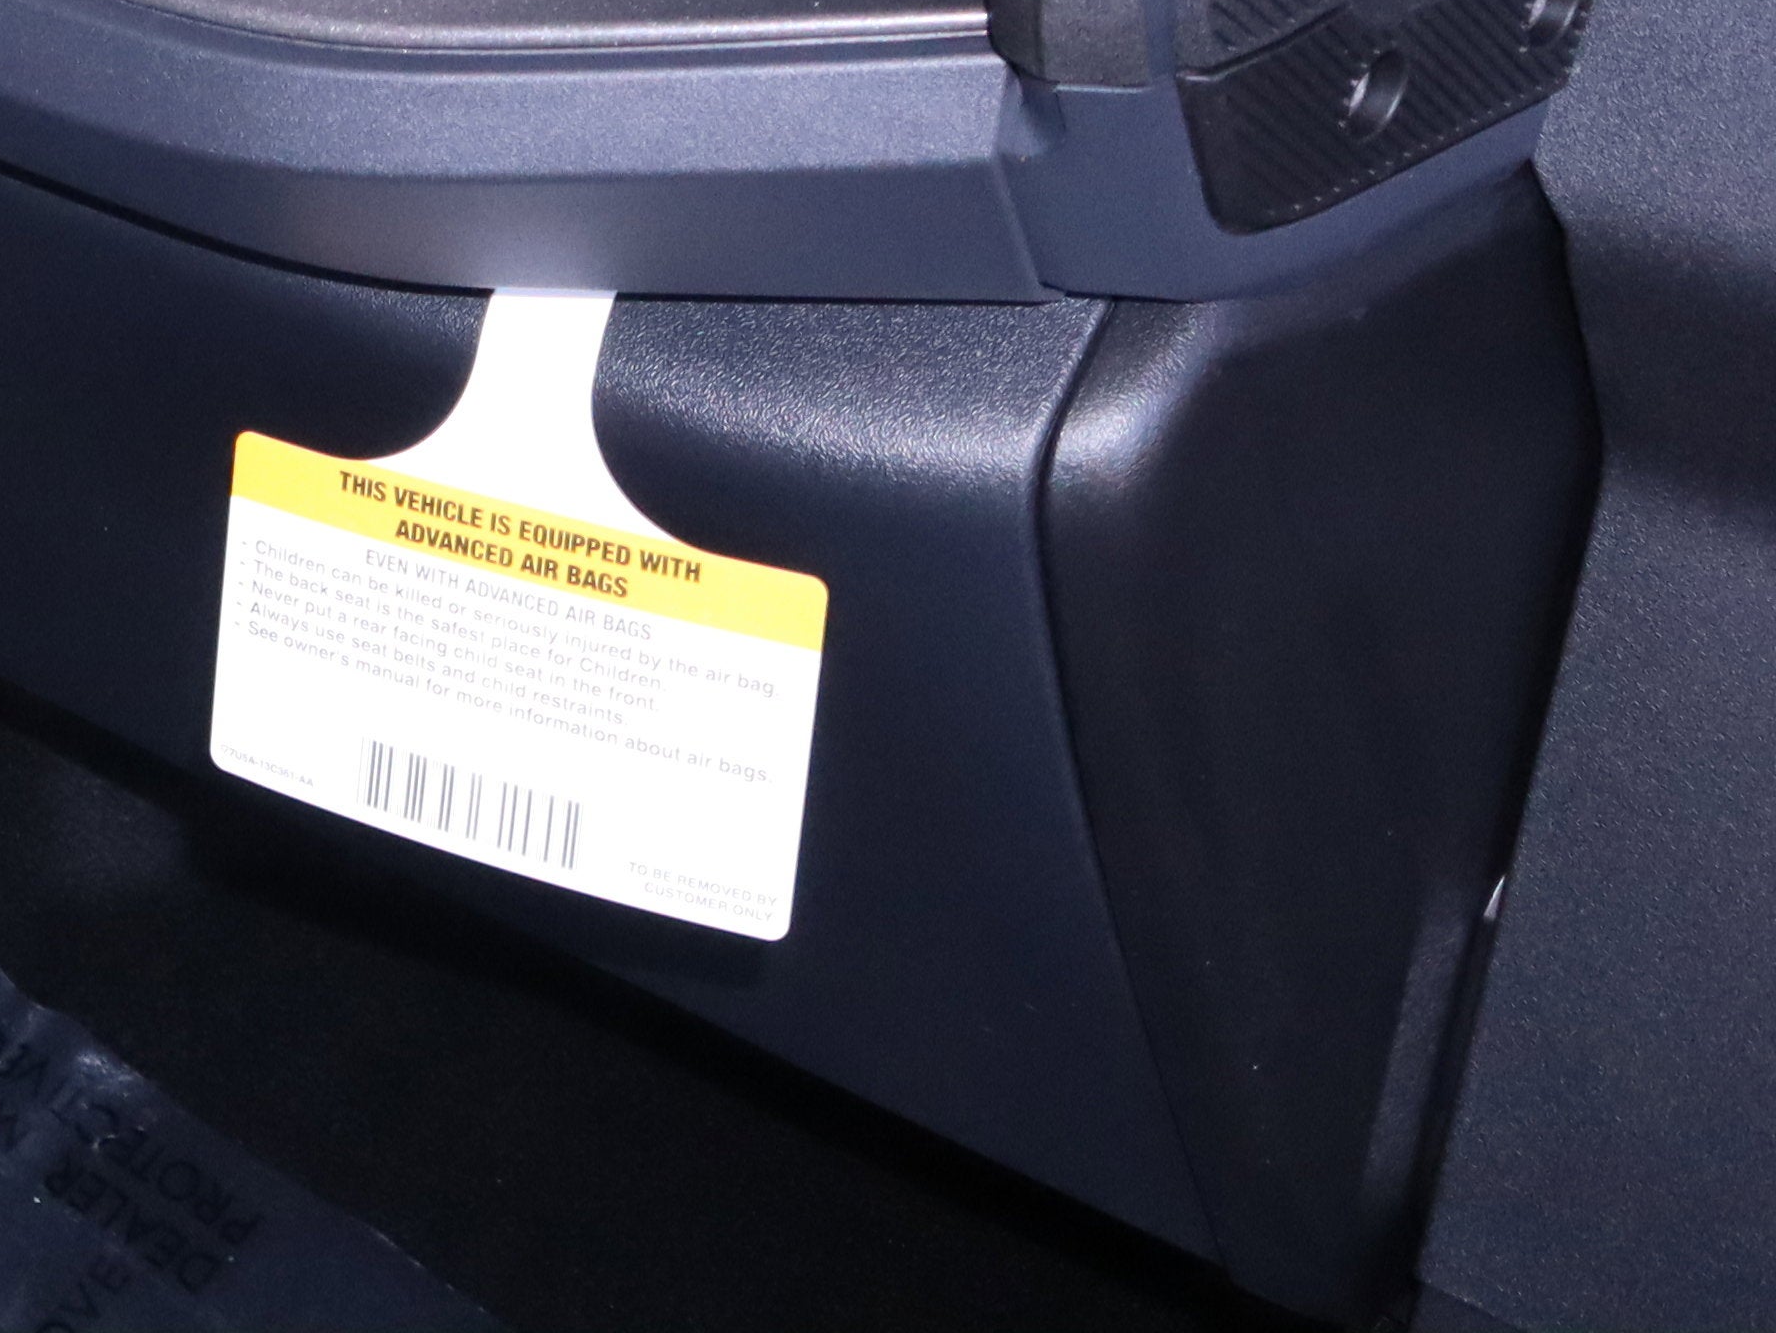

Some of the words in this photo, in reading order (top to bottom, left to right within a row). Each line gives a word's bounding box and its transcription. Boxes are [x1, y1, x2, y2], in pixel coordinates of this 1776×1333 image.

[339, 469, 386, 502] THIS
[393, 486, 482, 528] VEHICLE
[489, 513, 510, 536] IS
[518, 520, 631, 567] EQUIPPED
[639, 550, 701, 582] WITH
[395, 519, 513, 566] ADVANCED
[520, 553, 559, 578] AIR
[566, 564, 628, 597] BAGS
[250, 579, 300, 607] Never
[304, 599, 333, 622] put
[336, 610, 348, 624] a
[352, 615, 388, 636] rear
[392, 624, 448, 657] facing
[452, 646, 499, 669] child
[503, 660, 544, 684] seat
[548, 669, 567, 688] in
[572, 676, 603, 698] the
[608, 685, 661, 713] front.
[252, 558, 285, 583] The
[288, 570, 329, 598] back
[333, 588, 371, 612] seat
[375, 598, 392, 617] is
[396, 605, 425, 627] the
[430, 617, 486, 644] safest
[490, 635, 542, 660] place
[546, 647, 574, 668] for
[578, 656, 668, 693] Children.
[254, 539, 326, 576] Children
[331, 566, 362, 587] can
[367, 575, 389, 593] be
[394, 581, 443, 611] killed
[448, 602, 468, 617] or
[472, 608, 558, 645] seriously
[564, 630, 632, 662] injured
[638, 650, 663, 673] by
[668, 657, 699, 678] the
[704, 668, 733, 685] air
[736, 672, 780, 699] bag.
[365, 548, 409, 576] EVEN
[415, 562, 460, 590] WITH
[464, 577, 559, 617] ADVANCED
[564, 604, 597, 627] AIR
[602, 613, 652, 641] BAGS
[247, 620, 280, 643] See
[283, 632, 351, 665] owner's
[354, 654, 421, 690] manual
[425, 675, 452, 698] for
[455, 689, 504, 715] more
[508, 696, 619, 746] information
[623, 736, 681, 763] about
[686, 751, 713, 769] air
[717, 756, 774, 784] bags.
[248, 600, 311, 633] Always
[314, 619, 348, 640] use
[351, 628, 389, 652] seat
[392, 640, 437, 667] belts
[441, 659, 477, 683] and
[481, 669, 528, 698] child
[531, 686, 629, 729] restraints.
[628, 860, 649, 877] TO
[653, 867, 672, 884] BE
[676, 874, 753, 902] REMOVED
[756, 893, 780, 908] BY
[643, 880, 729, 912] CUSTOMER
[731, 903, 775, 923] ONLY
[40, 1155, 225, 1296] DEALER
